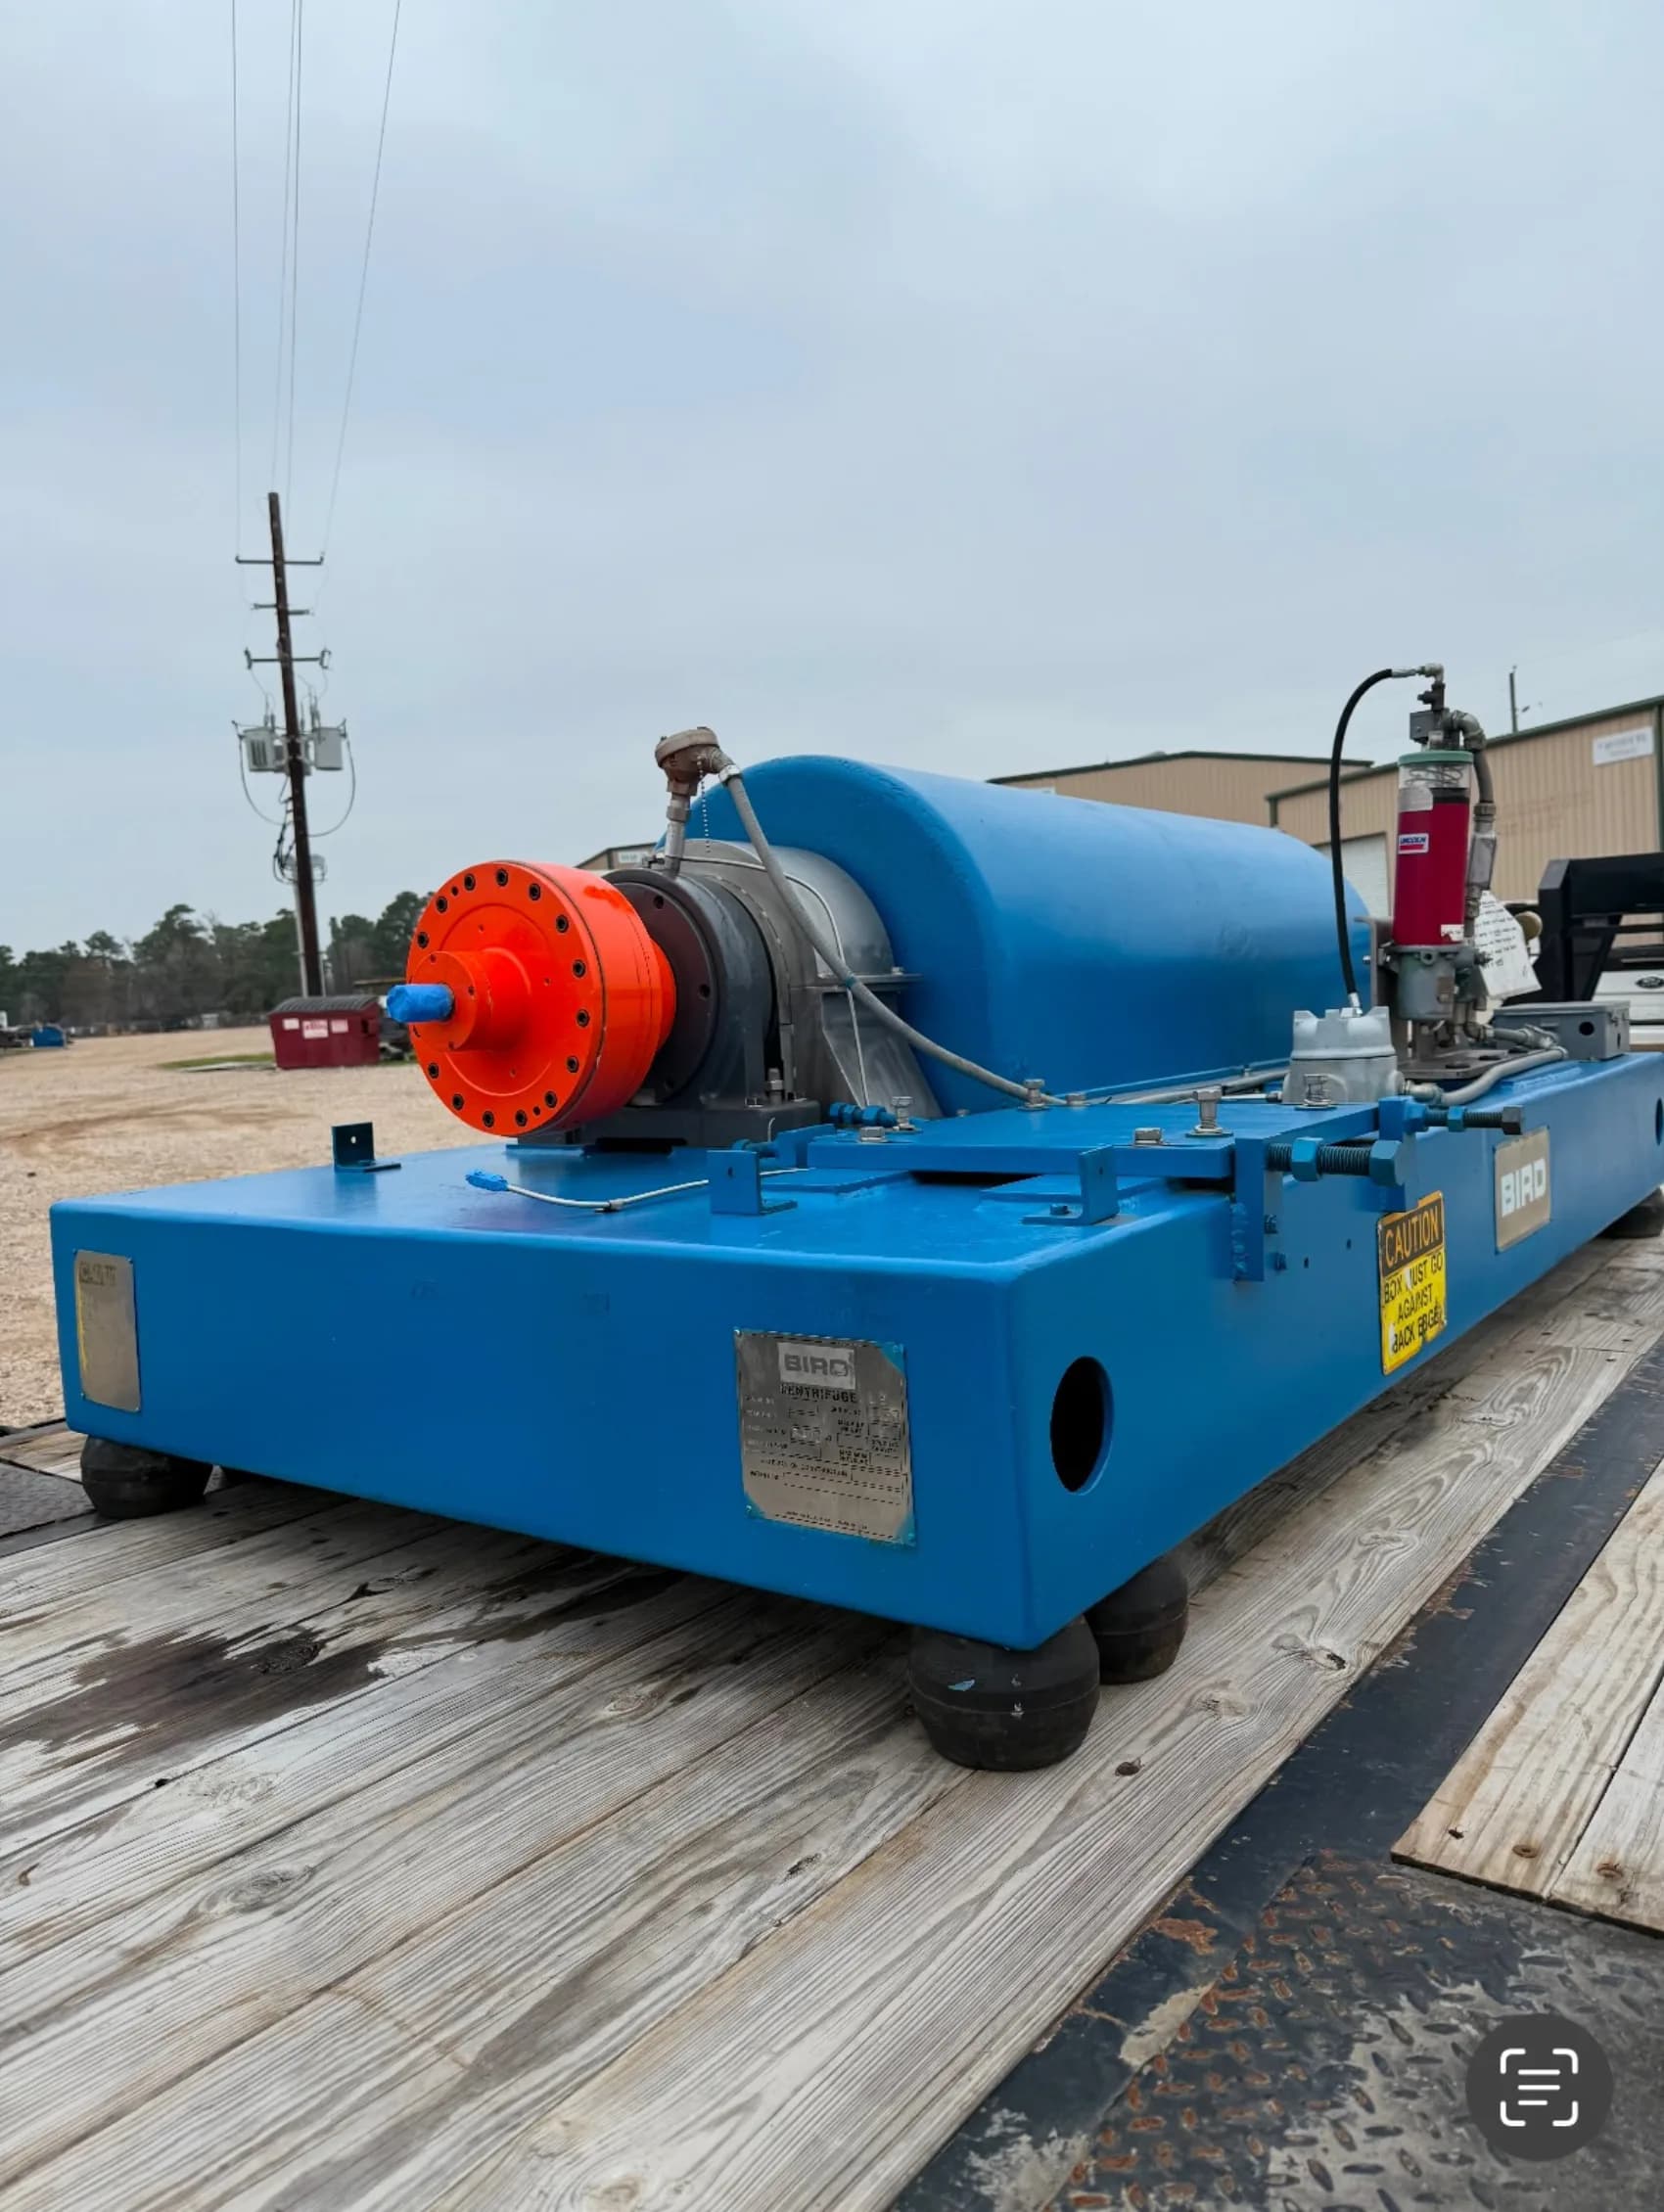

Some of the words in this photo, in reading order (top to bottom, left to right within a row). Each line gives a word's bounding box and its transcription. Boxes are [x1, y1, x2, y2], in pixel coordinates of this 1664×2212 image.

[1501, 1158, 1547, 1218] BIRD
[1385, 1205, 1439, 1267] CAUTION
[1384, 1274, 1403, 1304] BOX
[1430, 1251, 1443, 1274] GO
[1397, 1282, 1433, 1323] AGAINST
[784, 1354, 849, 1377] BIRD
